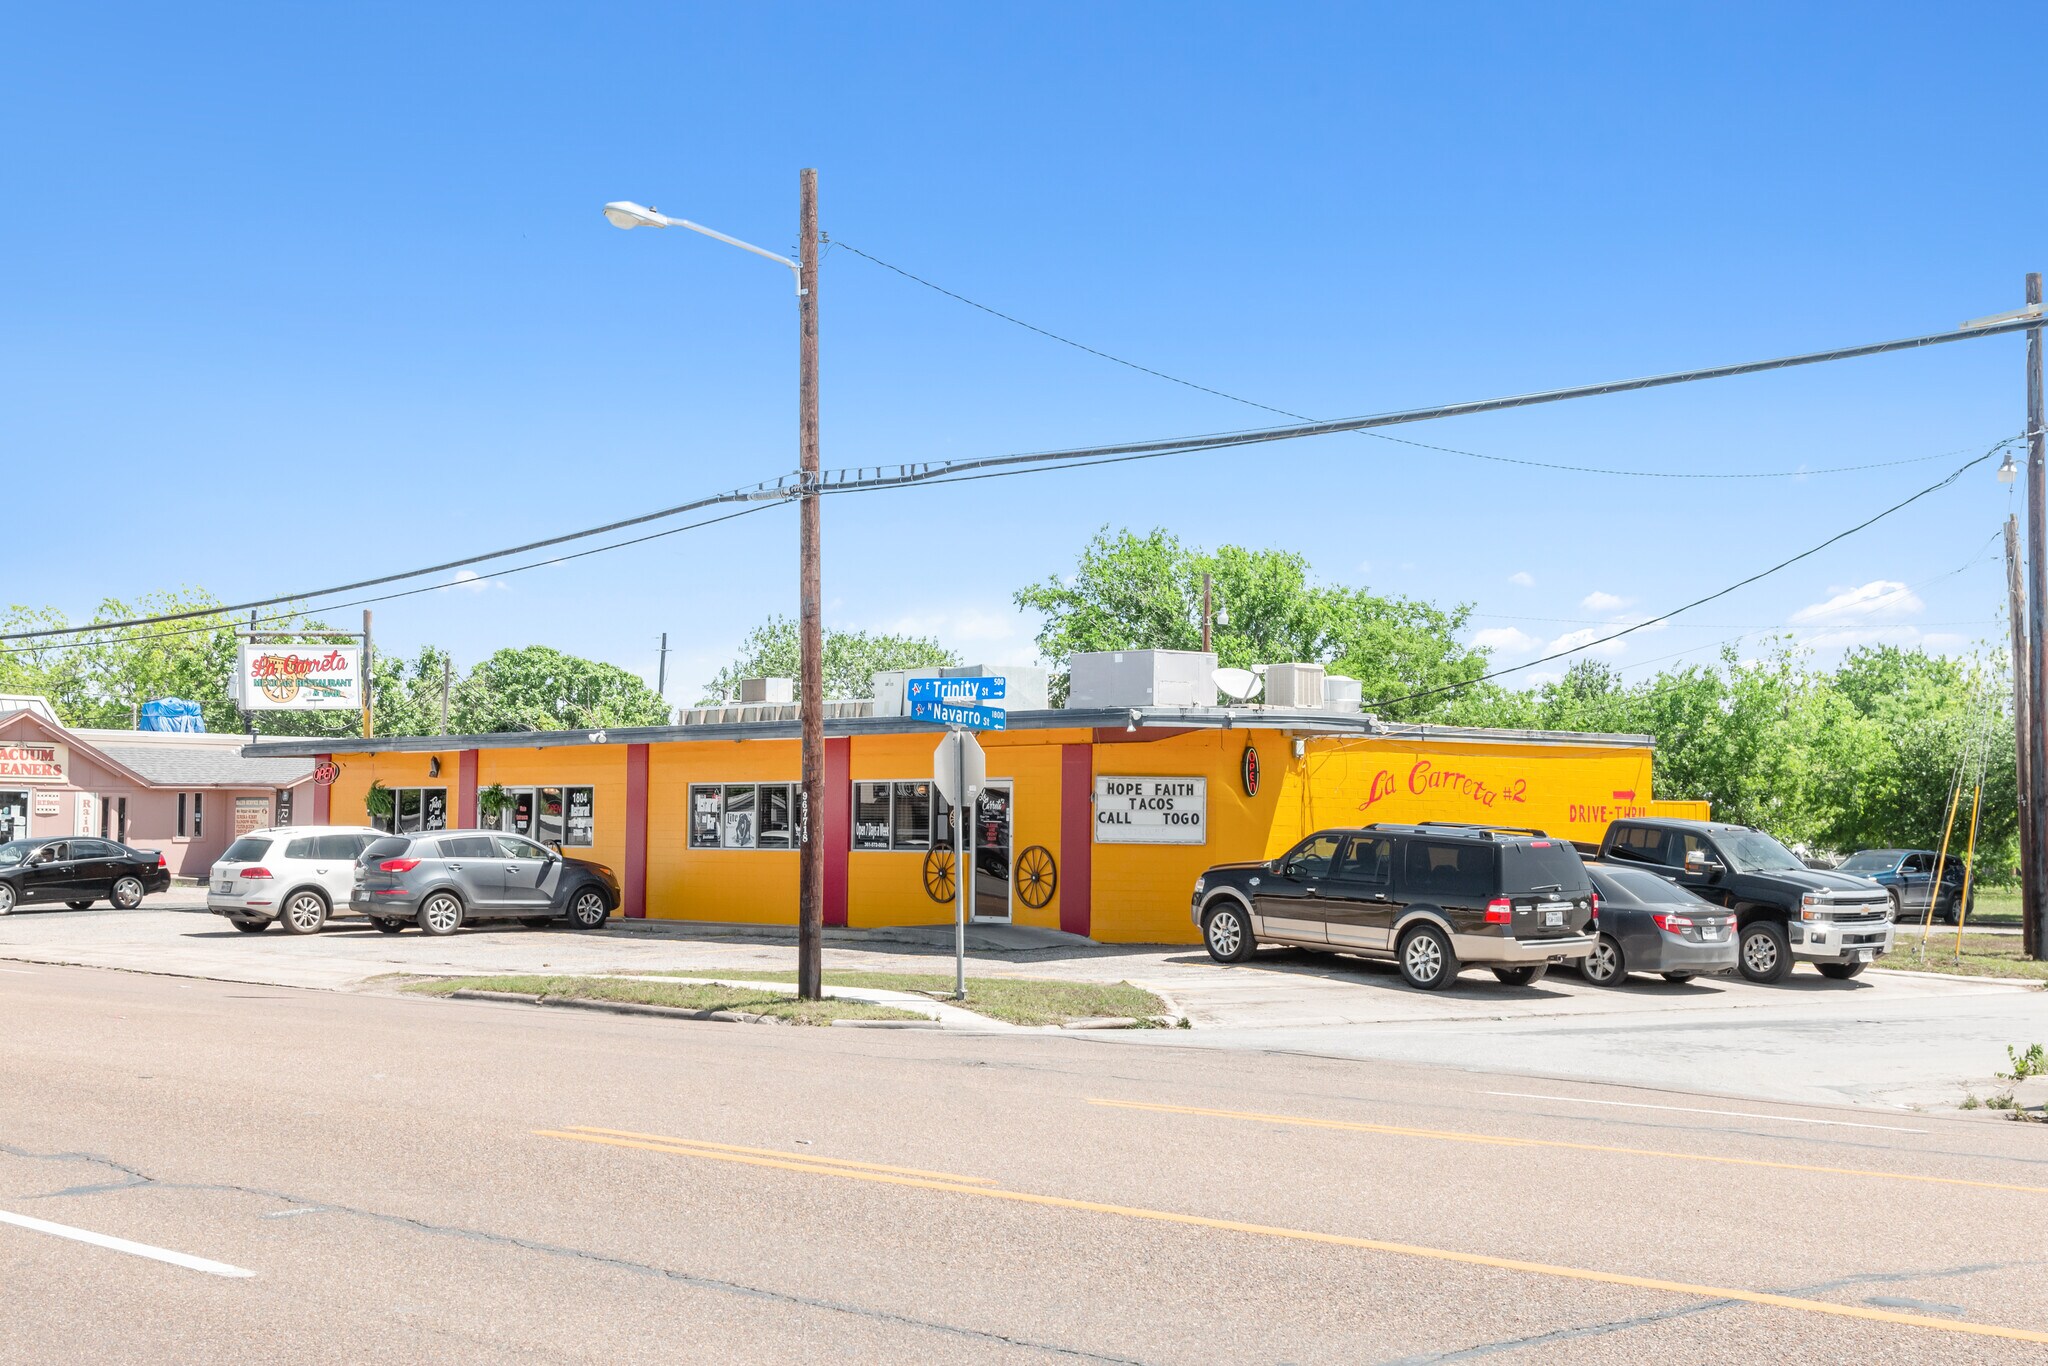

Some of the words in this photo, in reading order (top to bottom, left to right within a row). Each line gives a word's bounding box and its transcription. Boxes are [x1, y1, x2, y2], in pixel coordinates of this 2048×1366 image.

[251, 655, 278, 677] La
[283, 649, 349, 675] Carreta
[296, 678, 353, 687] RESTAURANT
[925, 682, 930, 690] E
[933, 680, 980, 698] Trinity
[981, 687, 989, 696] St
[993, 678, 1004, 686] 500
[927, 702, 932, 711] N
[933, 703, 980, 725] Navarro
[982, 717, 990, 726] St
[991, 710, 1004, 719] 1800
[0, 748, 55, 762] ACUUM
[314, 766, 336, 781] OPEN
[1107, 782, 1142, 795] HOPE
[1155, 783, 1194, 796] FAITH
[1358, 769, 1396, 811] La
[1408, 760, 1497, 807] Carreta
[1503, 778, 1527, 803] #2
[572, 792, 588, 803] 1804
[1129, 797, 1174, 810] TACOS
[82, 799, 91, 837] Rain
[1098, 811, 1132, 824] CALL
[855, 822, 865, 839] Open
